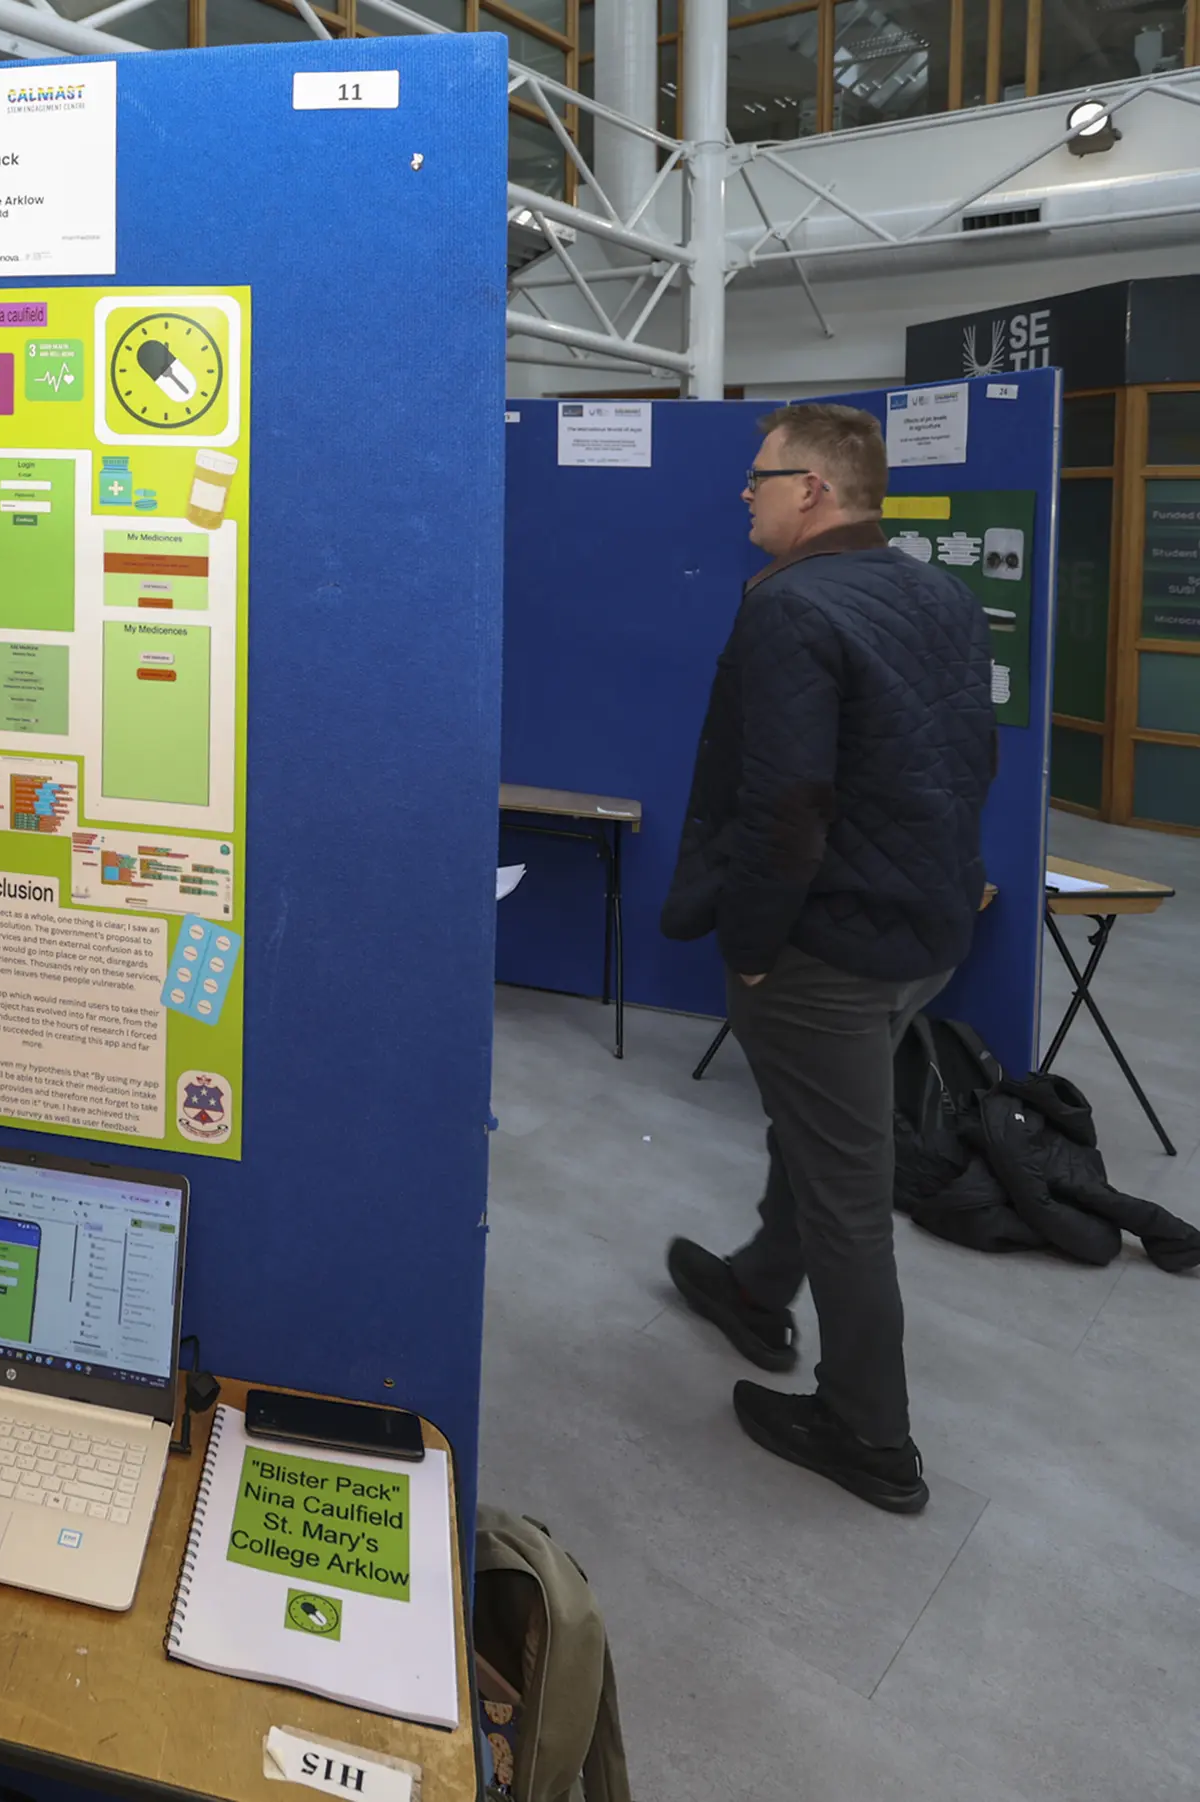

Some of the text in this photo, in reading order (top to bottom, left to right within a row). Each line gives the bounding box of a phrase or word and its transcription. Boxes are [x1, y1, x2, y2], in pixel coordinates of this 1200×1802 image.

[6, 84, 86, 103] CALMAST
[339, 84, 362, 100] 11
[7, 106, 22, 114] STEM
[23, 104, 62, 113] ENGAGEMENT
[5, 196, 44, 205] Arklow
[7, 307, 43, 322] caulfield
[1009, 309, 1050, 349] SE
[29, 344, 36, 357] 3
[1009, 348, 1049, 372] TU
[18, 461, 35, 469] Login
[1153, 511, 1194, 519] Funded
[1153, 549, 1197, 558] Student
[124, 624, 137, 634] My
[13, 968, 37, 978] leaves
[39, 972, 61, 981] these
[62, 977, 89, 985] people
[16, 1110, 42, 1119] survey
[245, 1483, 403, 1529] Nina Caulfield
[264, 1513, 379, 1556] St. Mary's
[231, 1530, 409, 1586] College Arklow
[301, 1751, 366, 1793] H15
